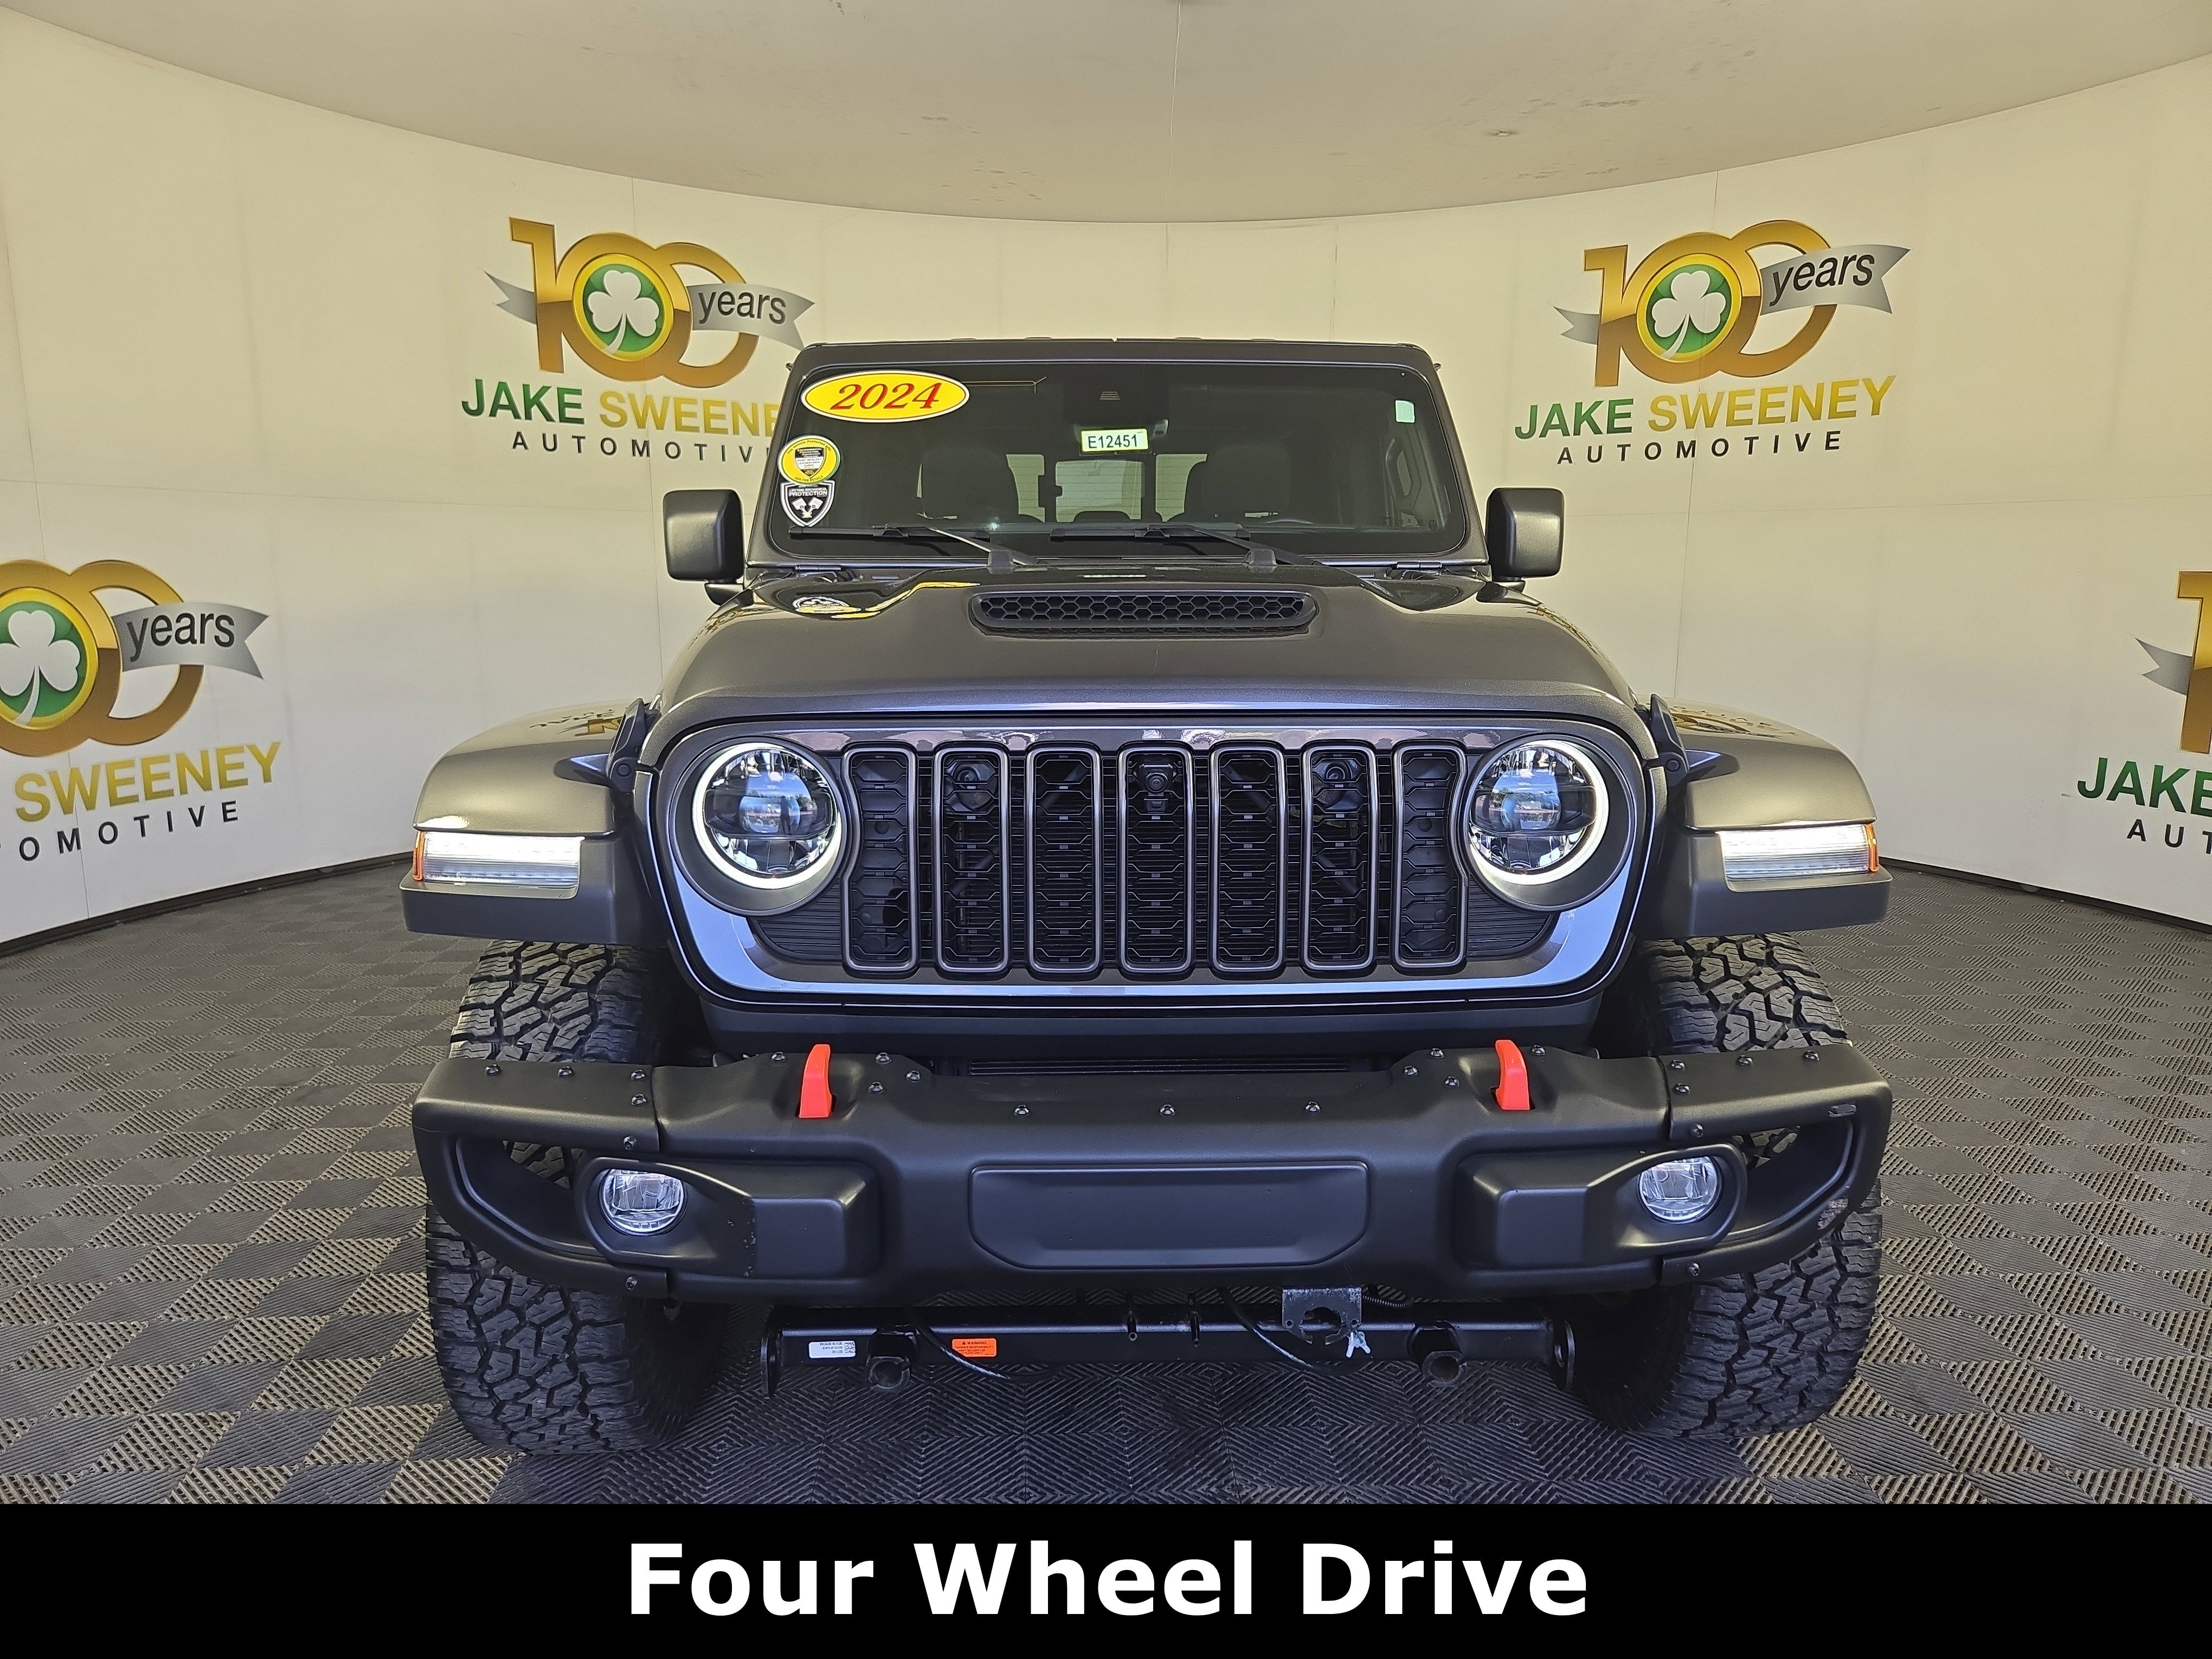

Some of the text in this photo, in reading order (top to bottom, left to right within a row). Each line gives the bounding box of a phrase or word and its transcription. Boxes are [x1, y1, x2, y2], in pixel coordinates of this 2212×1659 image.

[1769, 254, 1876, 307] years
[698, 290, 787, 324] years
[461, 378, 586, 425] JAKE
[829, 382, 943, 410] 2024
[1515, 374, 1897, 440] JAKE SWEENEY
[512, 430, 770, 464] AUTOMOTIV
[1088, 434, 1137, 448] E12451
[1557, 430, 1841, 465] AUTOMOTIVE
[126, 613, 235, 661] years
[14, 741, 281, 822] SWEENEY
